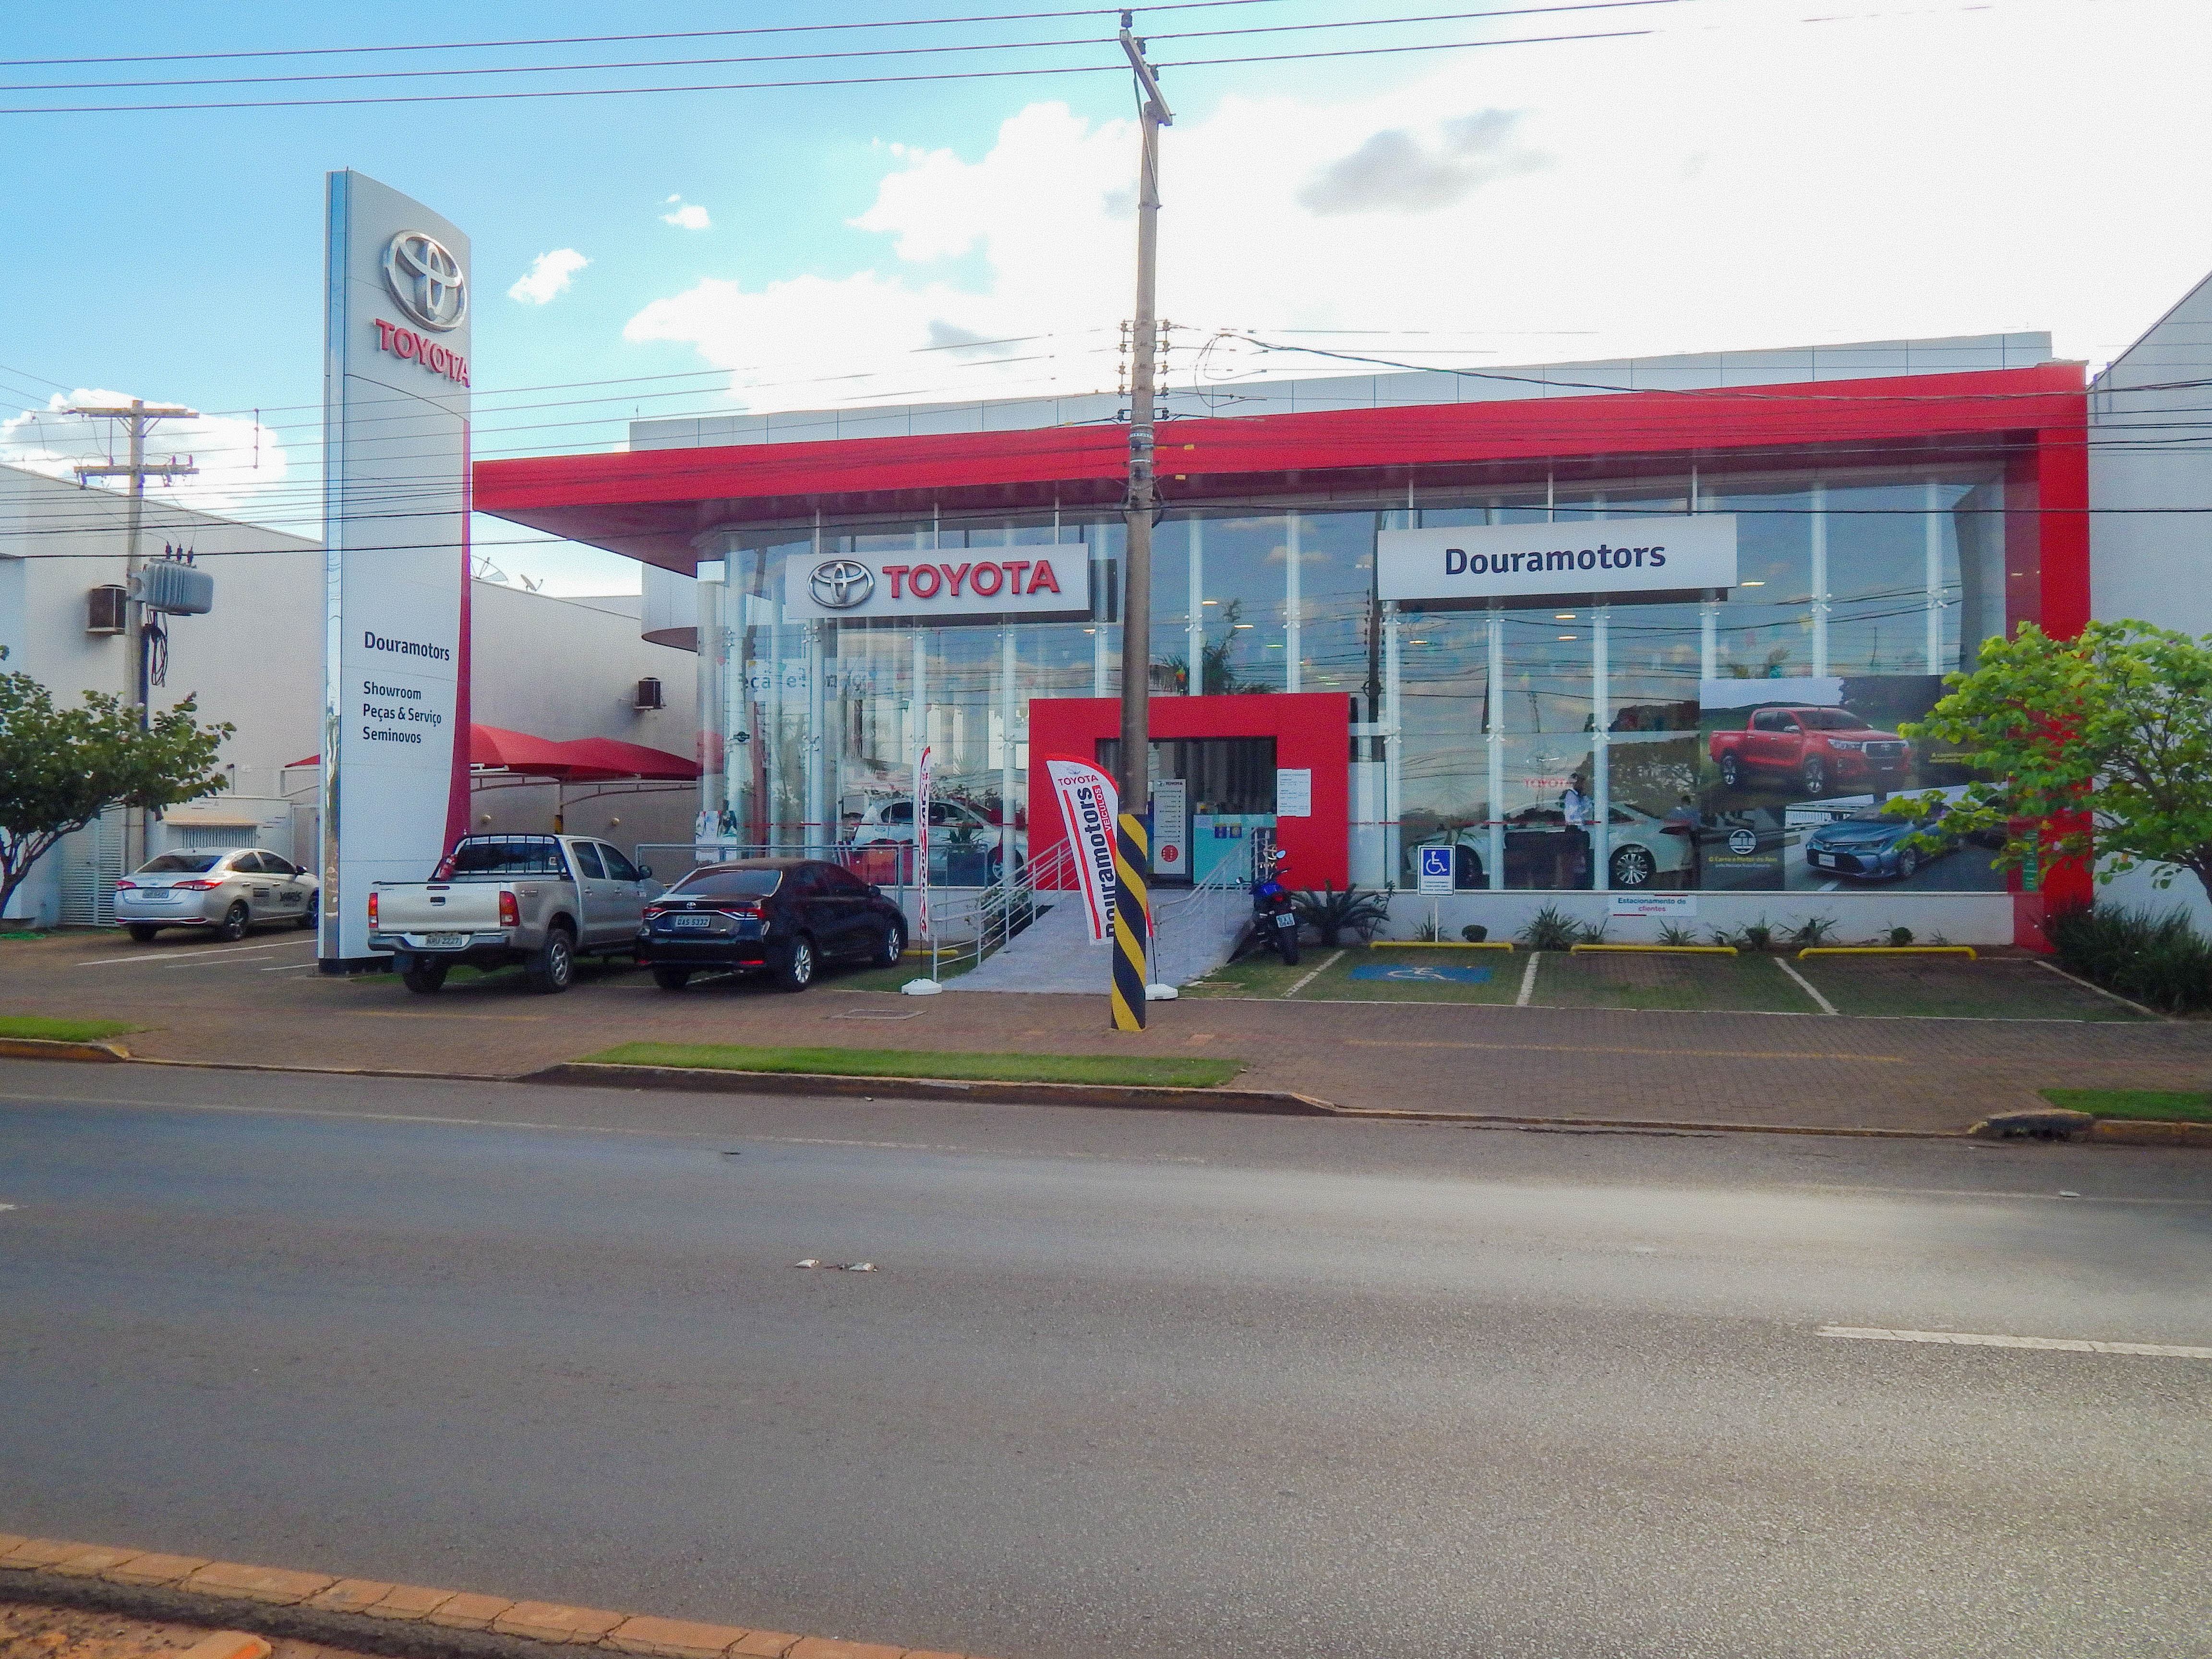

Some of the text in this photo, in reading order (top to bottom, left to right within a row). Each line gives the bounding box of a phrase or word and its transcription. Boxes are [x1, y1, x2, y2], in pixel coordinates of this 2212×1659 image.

[374, 318, 470, 387] TOYOTA
[1446, 543, 1666, 575] Douramotors
[882, 559, 1060, 599] TOYOTA
[364, 631, 450, 661] Douramotors
[363, 681, 421, 700] Showroom
[363, 703, 442, 727] Peças & Serviço
[363, 726, 421, 744] Seminovos
[1058, 774, 1099, 786] TOYOTA
[1095, 788, 1112, 831] VEÍCULOS
